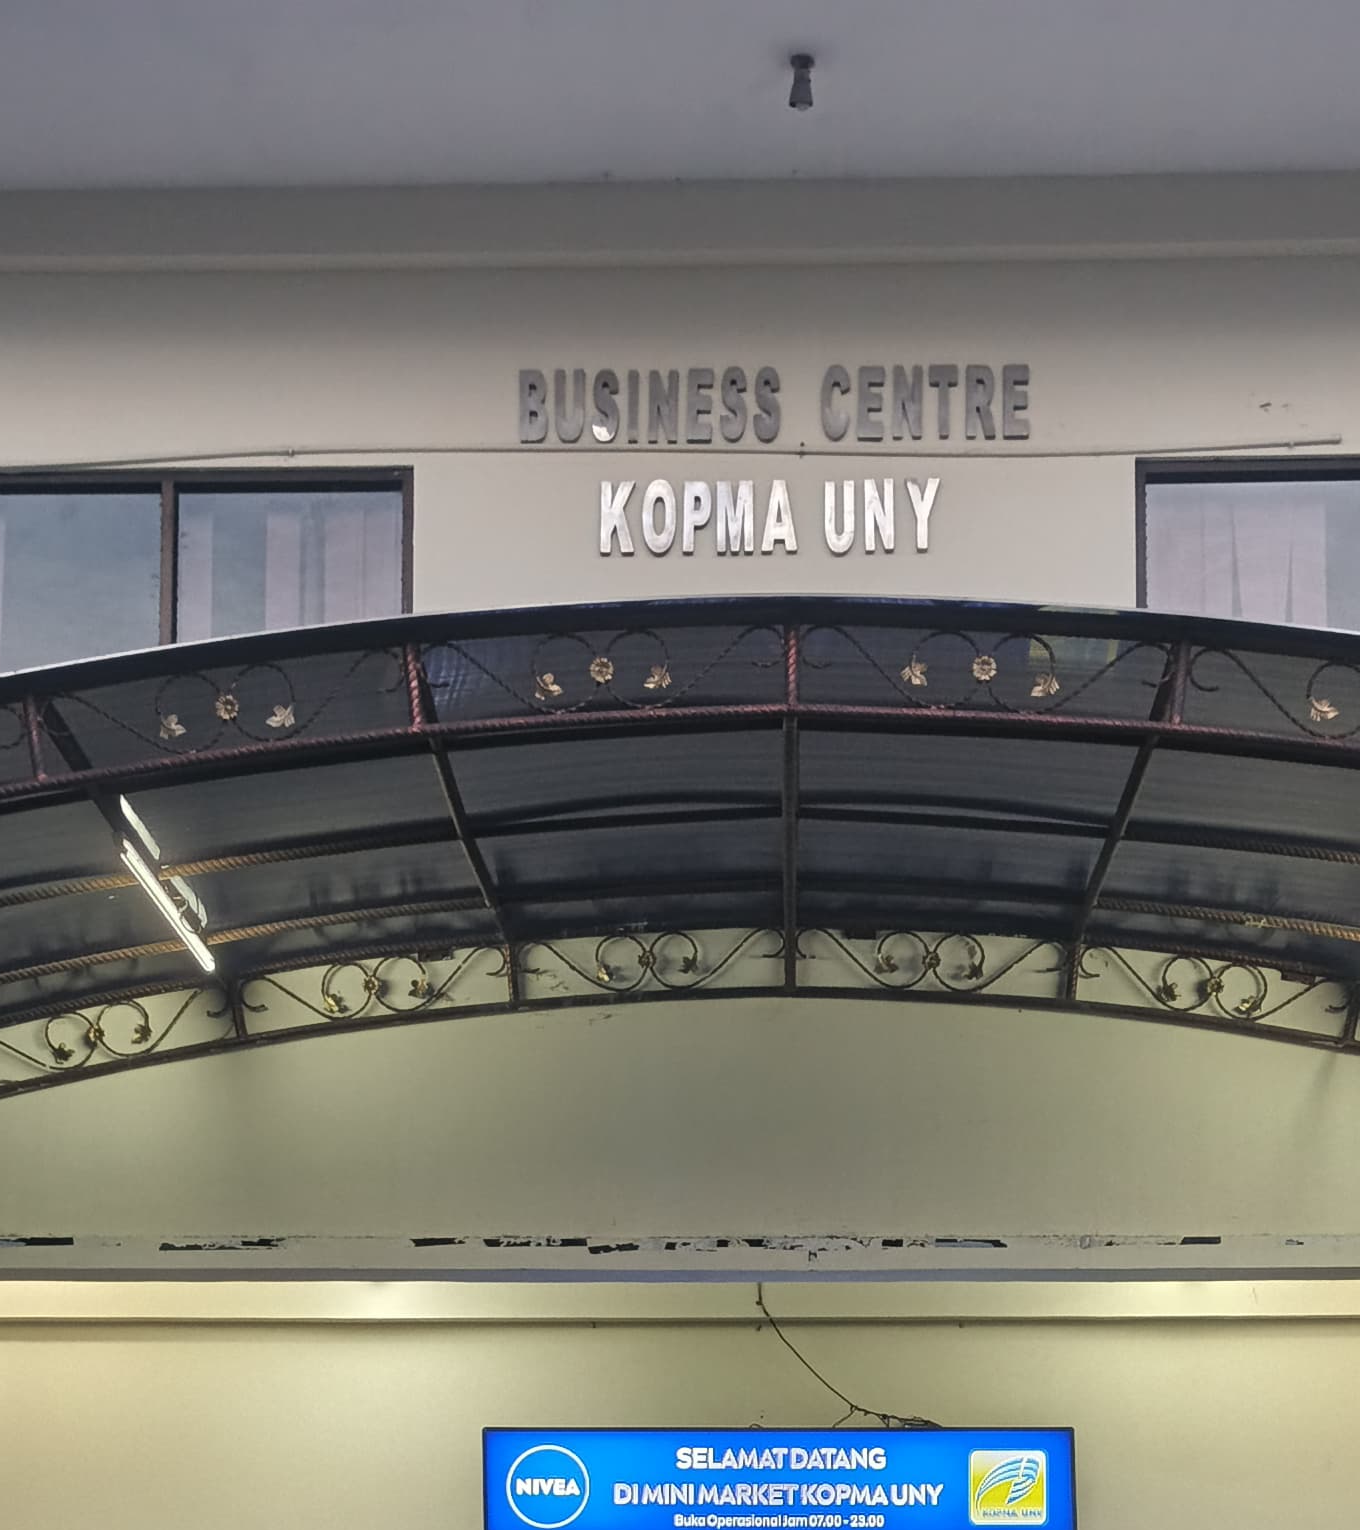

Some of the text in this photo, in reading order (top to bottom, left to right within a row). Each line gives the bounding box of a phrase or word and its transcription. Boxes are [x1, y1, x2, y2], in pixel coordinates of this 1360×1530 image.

[518, 363, 1031, 445] BUSINESS CENTRE
[599, 476, 941, 556] KOPMA UNY
[675, 1446, 888, 1470] SELAMAT DATANG
[515, 1477, 581, 1496] NIVEA
[613, 1482, 945, 1506] DI MINI MARKET KOPMA UNY
[673, 1514, 705, 1527] Buka
[706, 1514, 782, 1530] Operasional
[782, 1514, 808, 1528] Jam
[809, 1514, 842, 1528] 07.00
